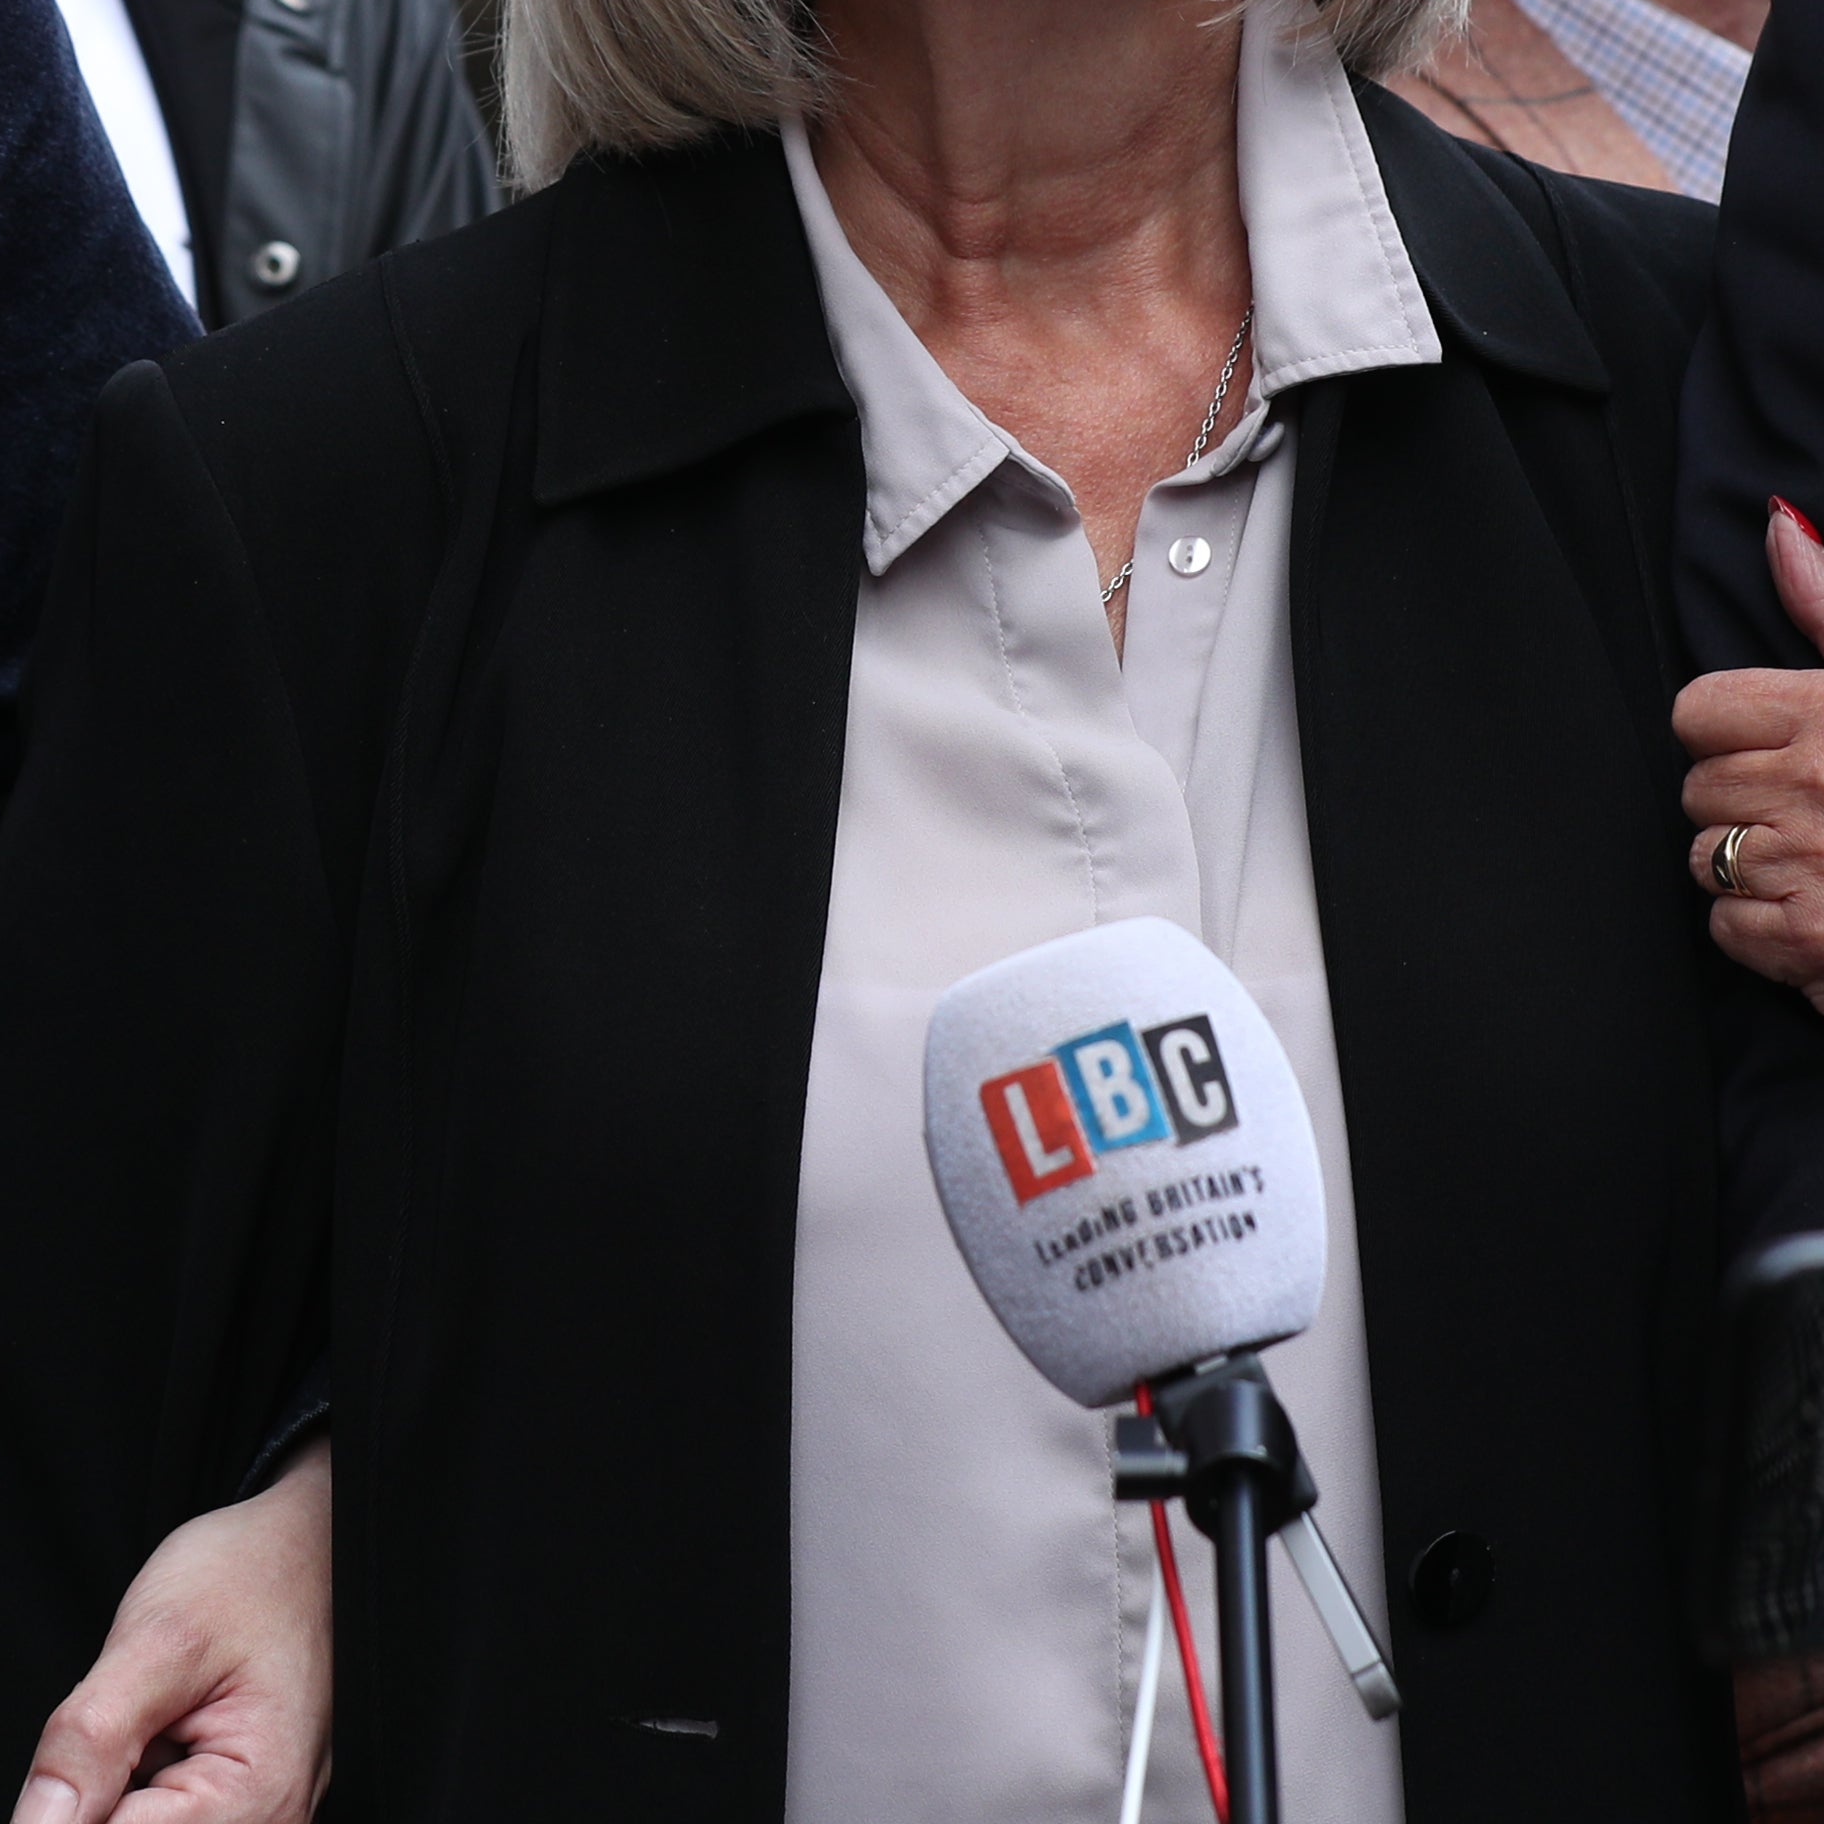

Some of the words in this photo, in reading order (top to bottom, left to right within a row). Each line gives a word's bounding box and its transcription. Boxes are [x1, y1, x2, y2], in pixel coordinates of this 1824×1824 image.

[1004, 1028, 1228, 1178] LBC
[1145, 1165, 1264, 1217] BRITAIN'S
[1074, 1211, 1258, 1292] CONVERSATION
